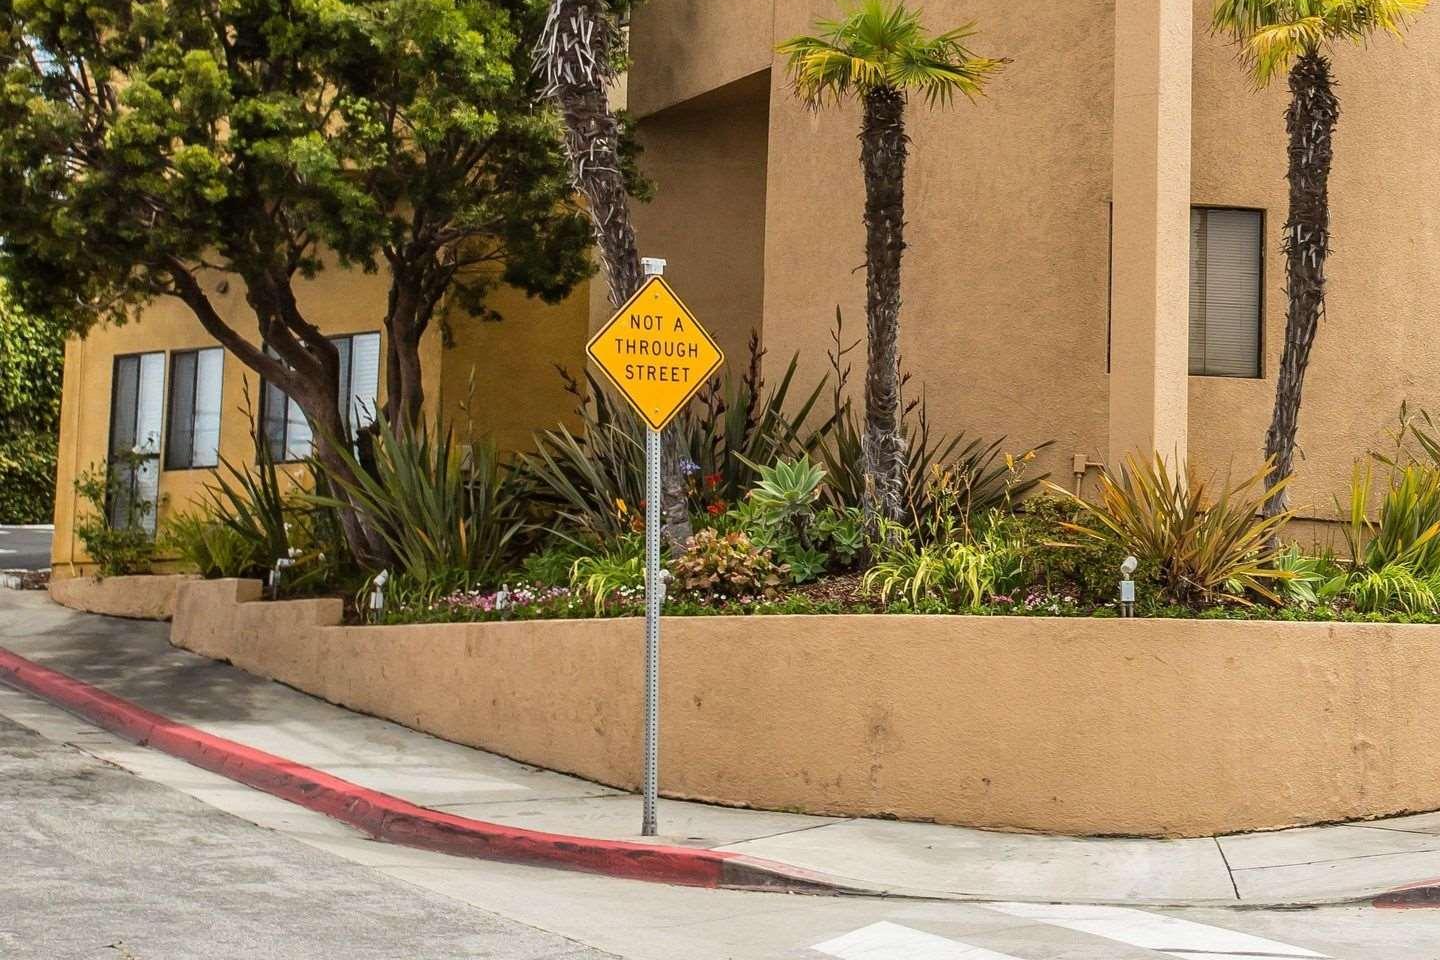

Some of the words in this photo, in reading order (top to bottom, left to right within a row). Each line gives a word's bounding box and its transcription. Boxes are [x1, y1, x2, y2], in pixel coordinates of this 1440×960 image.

[630, 314, 663, 331] NOT
[673, 317, 684, 332] A
[615, 338, 698, 359] THROUGH
[625, 364, 690, 383] STREET
